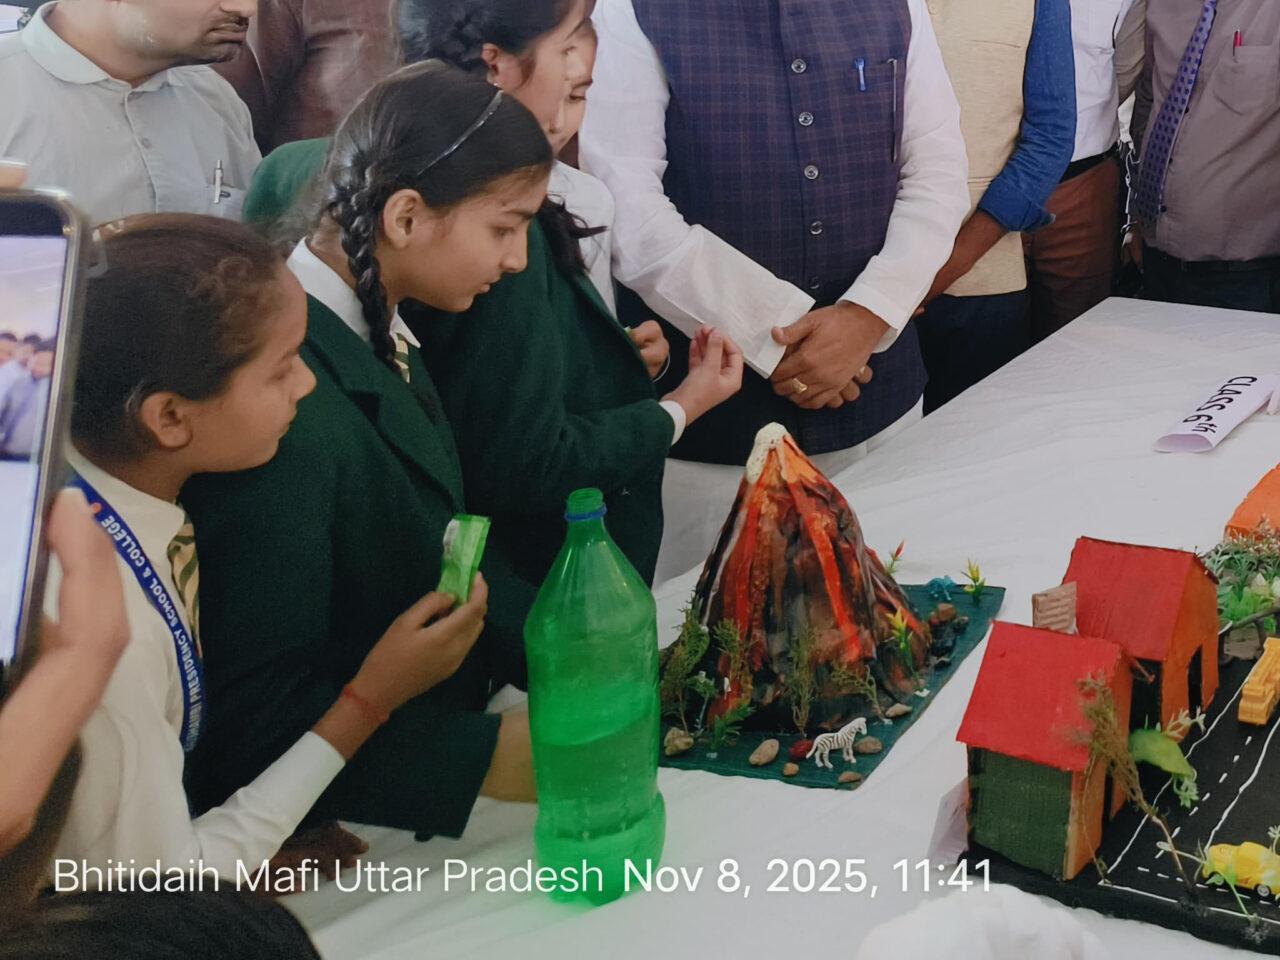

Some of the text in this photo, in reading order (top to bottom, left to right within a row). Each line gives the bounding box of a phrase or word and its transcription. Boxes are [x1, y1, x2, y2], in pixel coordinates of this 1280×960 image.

[1182, 376, 1258, 434] CLASS 6th
[101, 515, 145, 567] COLLEGE
[149, 578, 179, 628] SCHOOL
[173, 628, 202, 703] PRESIDENCY
